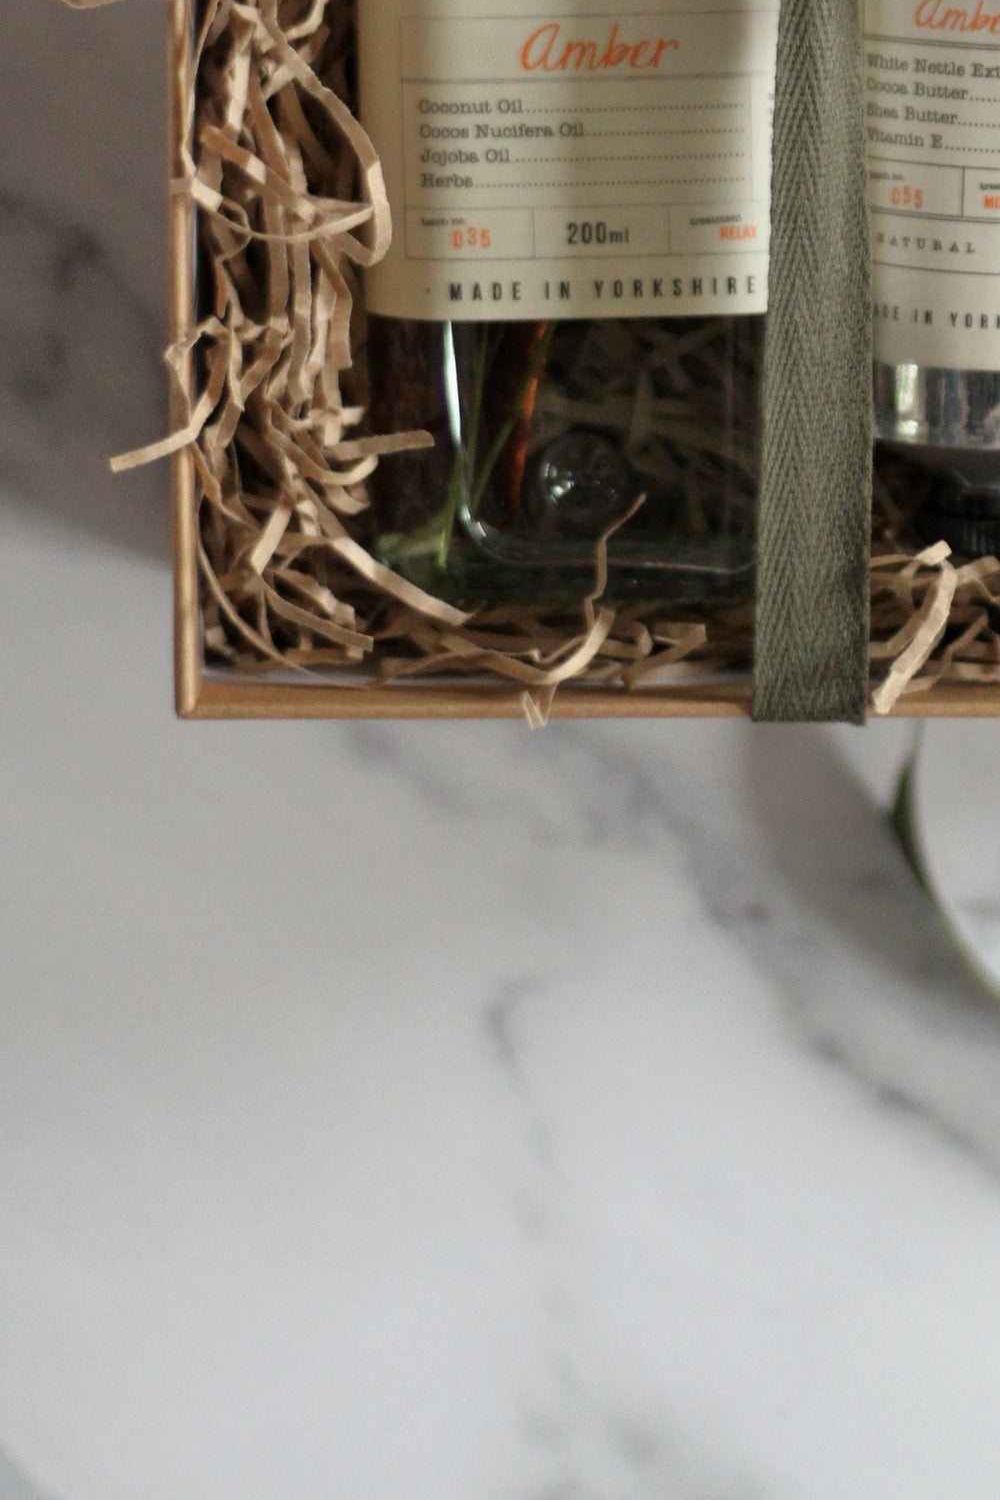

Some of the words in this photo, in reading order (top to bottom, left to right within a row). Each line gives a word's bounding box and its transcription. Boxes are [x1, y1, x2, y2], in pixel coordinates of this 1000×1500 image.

[866, 53, 909, 72] White
[914, 58, 966, 77] Nettle
[866, 77, 908, 95] Cocoa
[913, 81, 969, 101] Butter
[418, 99, 492, 115] Coconut
[497, 98, 523, 115] Oil
[904, 106, 958, 125] Butter
[419, 123, 470, 139] Cocos
[474, 121, 555, 139] Nucifera
[559, 121, 584, 138] Oil
[866, 127, 924, 147] Vitamin
[930, 134, 943, 149] E
[420, 149, 479, 167] Jojoba
[484, 148, 511, 164] Oil
[420, 172, 474, 188] Herbs
[874, 233, 977, 255] NATURAL
[449, 281, 523, 302] MADE
[543, 279, 572, 299] IN
[592, 274, 757, 297] YORKSHIRE
[912, 308, 934, 325] IN
